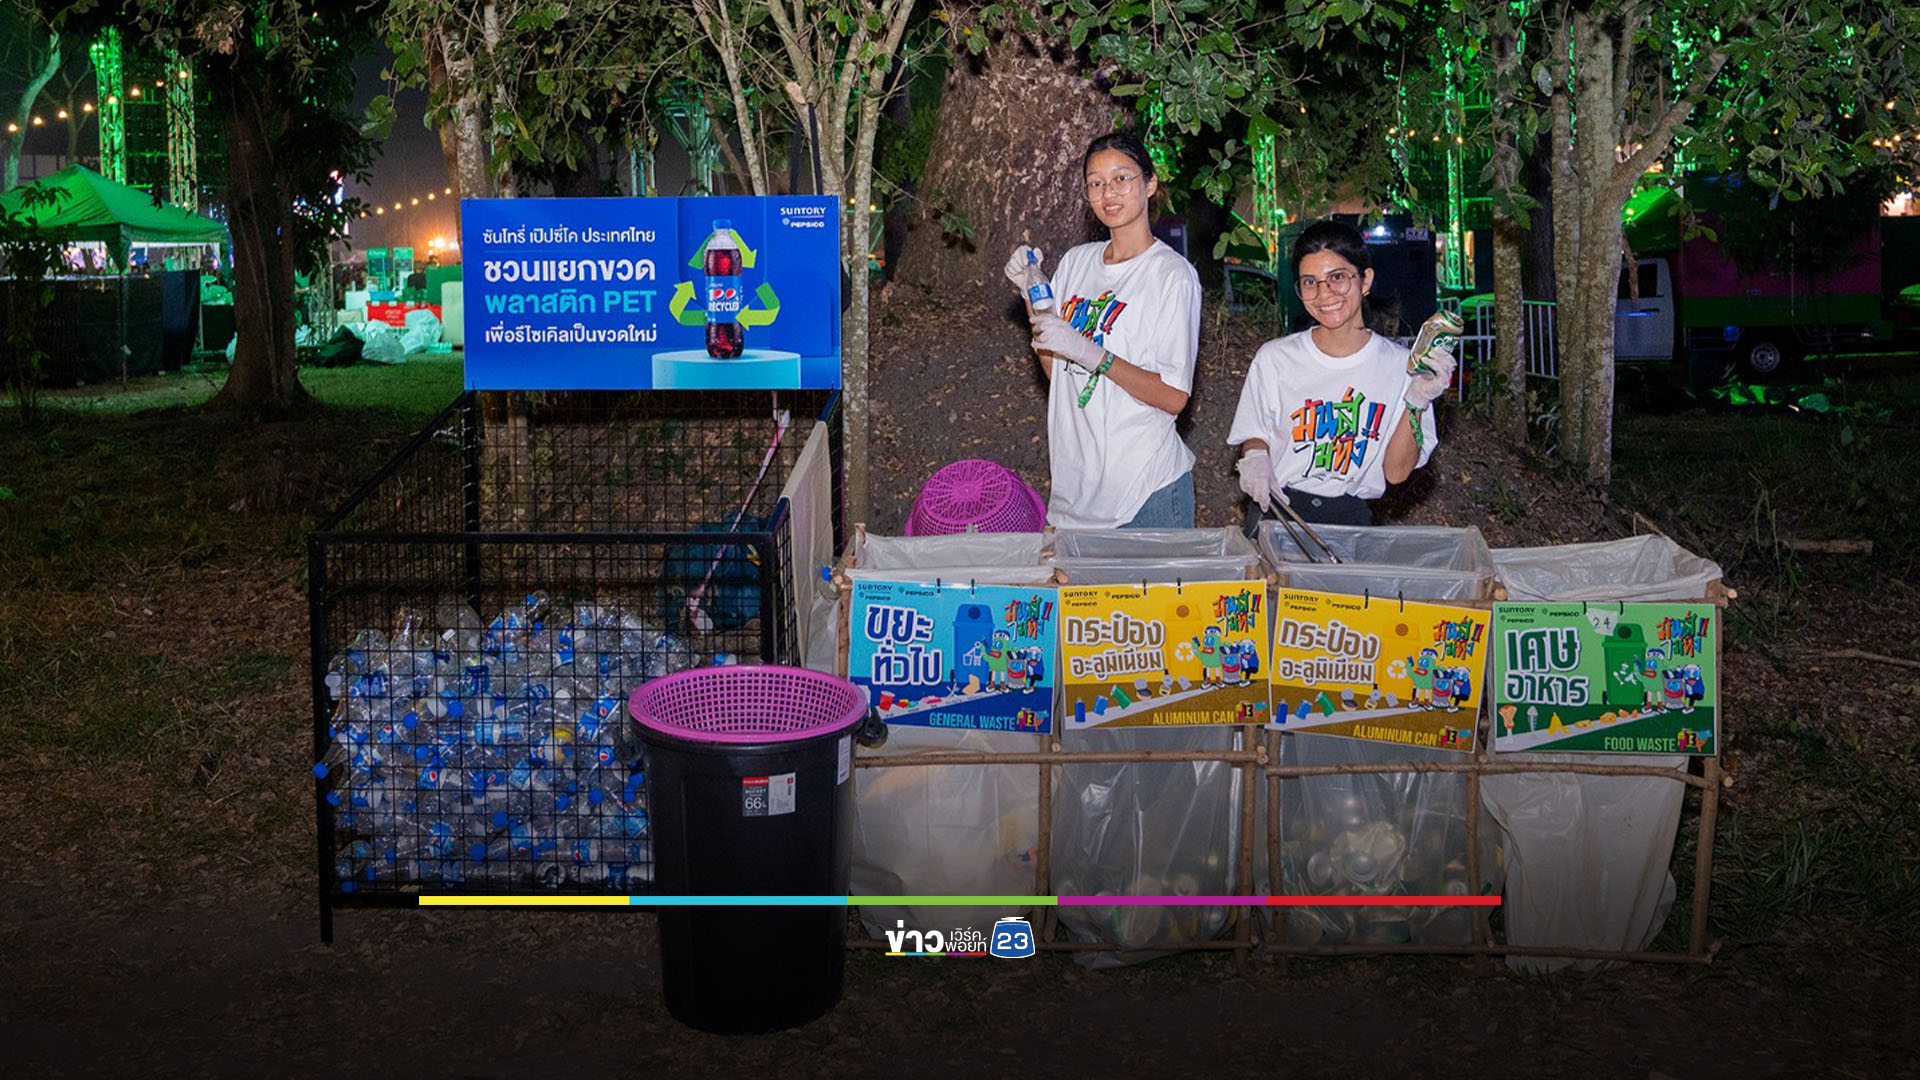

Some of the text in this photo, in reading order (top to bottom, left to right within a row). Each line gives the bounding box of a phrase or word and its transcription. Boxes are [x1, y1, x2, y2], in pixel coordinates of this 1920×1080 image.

[780, 206, 826, 216] SUNTORY
[483, 224, 526, 244] ซันโทรี่
[582, 226, 656, 244] ประเทศไทย
[484, 259, 656, 282] ชวนแยกขวด
[485, 288, 657, 314] พลาสติก PET
[485, 320, 657, 344] เพื่อรีไซเคิลเป็นขวดใหม่
[866, 604, 934, 644] ขยะ
[1066, 611, 1165, 648] กระป๋อง
[1279, 618, 1380, 662] กระป๋อง
[1505, 627, 1581, 672] เศษ
[872, 638, 942, 685] ทั่วไป
[1070, 648, 1164, 680] อะลูมิเนียม
[1279, 656, 1374, 686] อะลูมิเนียม
[1505, 673, 1589, 706] อาหาร
[929, 711, 1016, 731] GENERAL WASTE
[1152, 710, 1235, 725] ALUMINUM CAN
[1353, 724, 1437, 747] ALUMINUM CAN
[1604, 736, 1676, 752] FOOD WASTE
[745, 797, 762, 810] 66
